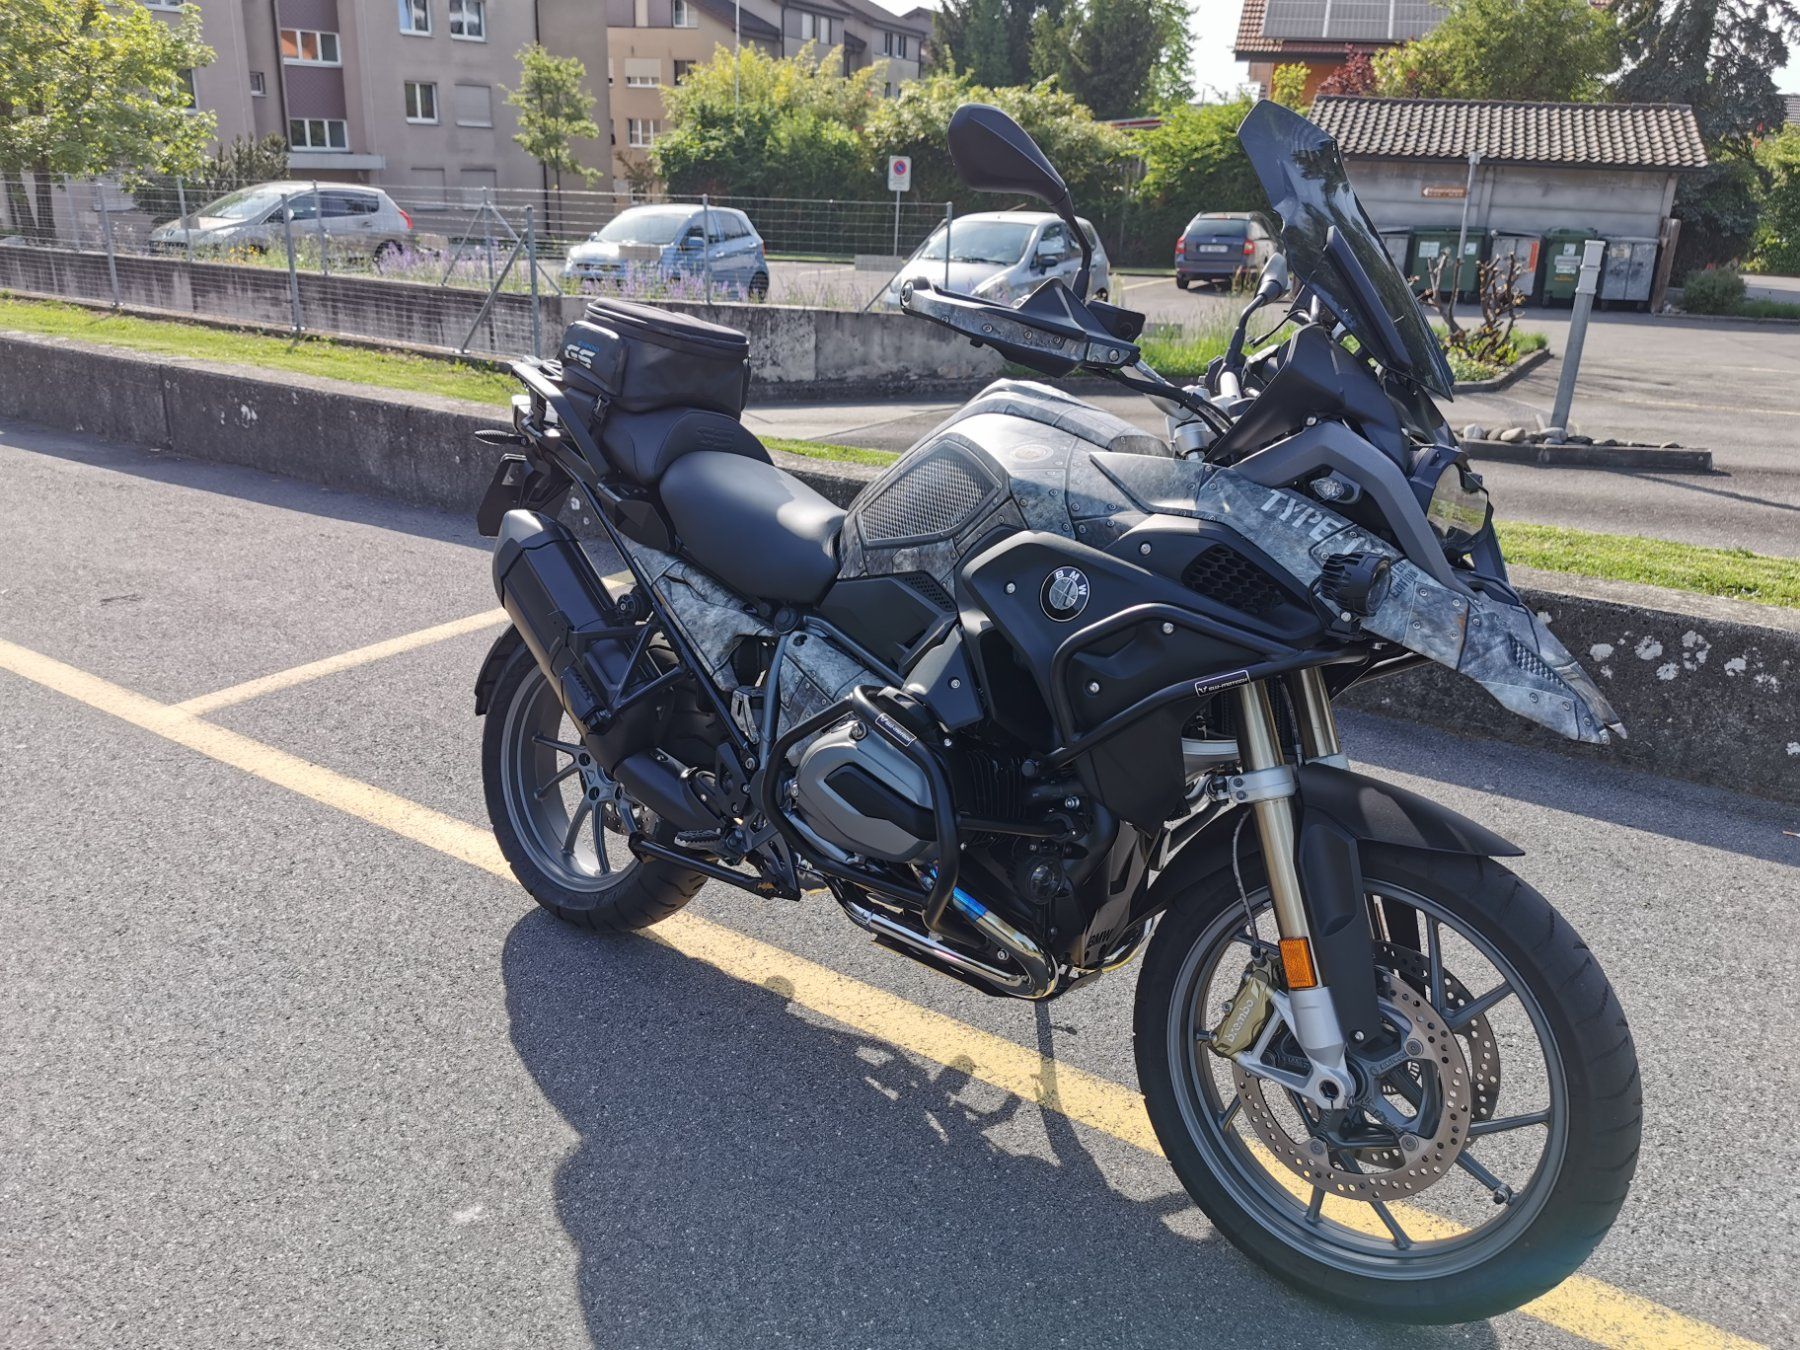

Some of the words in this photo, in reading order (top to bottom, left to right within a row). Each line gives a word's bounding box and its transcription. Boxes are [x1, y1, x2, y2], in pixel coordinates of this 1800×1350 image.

[564, 343, 597, 369] GS
[1054, 569, 1088, 596] BMW
[1225, 999, 1254, 1043] brembo
